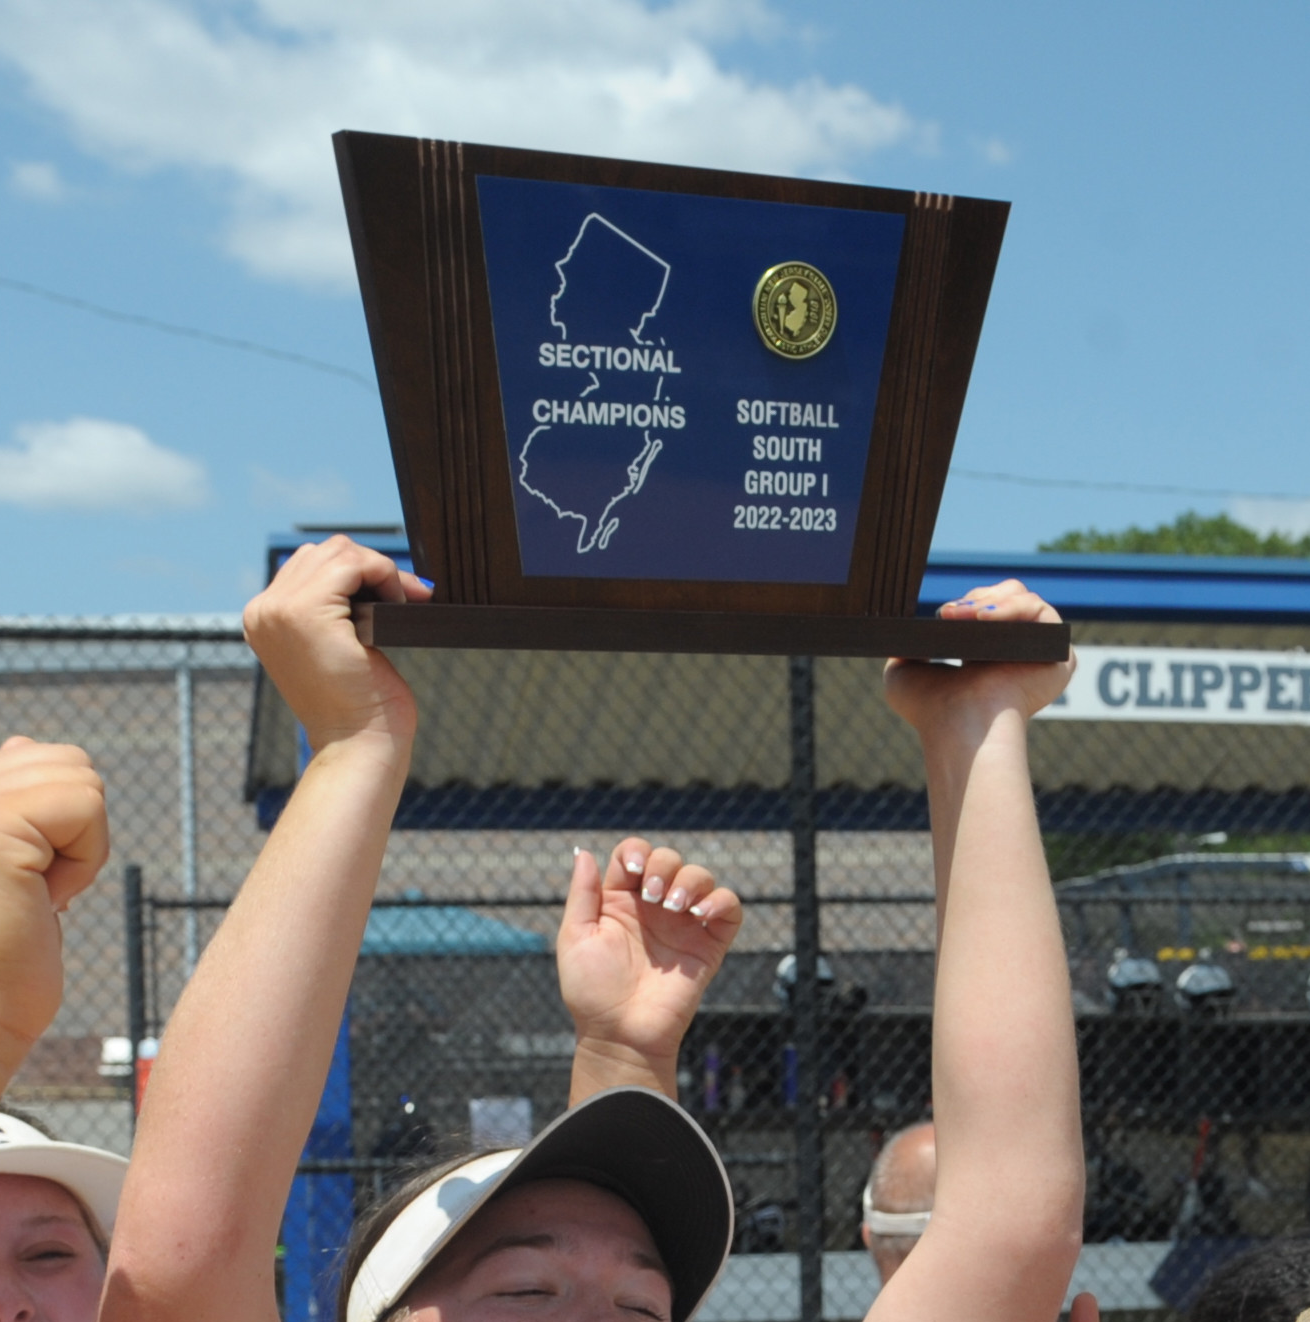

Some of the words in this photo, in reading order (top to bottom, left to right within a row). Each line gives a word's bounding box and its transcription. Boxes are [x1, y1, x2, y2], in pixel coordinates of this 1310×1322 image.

[539, 342, 682, 373] SECTIONAL
[532, 398, 686, 429] CHAMPIONS
[736, 399, 840, 428] SOFTBALL
[752, 435, 822, 462] SOUTH
[744, 469, 817, 496] GROUP
[733, 504, 837, 531] 2022-2023
